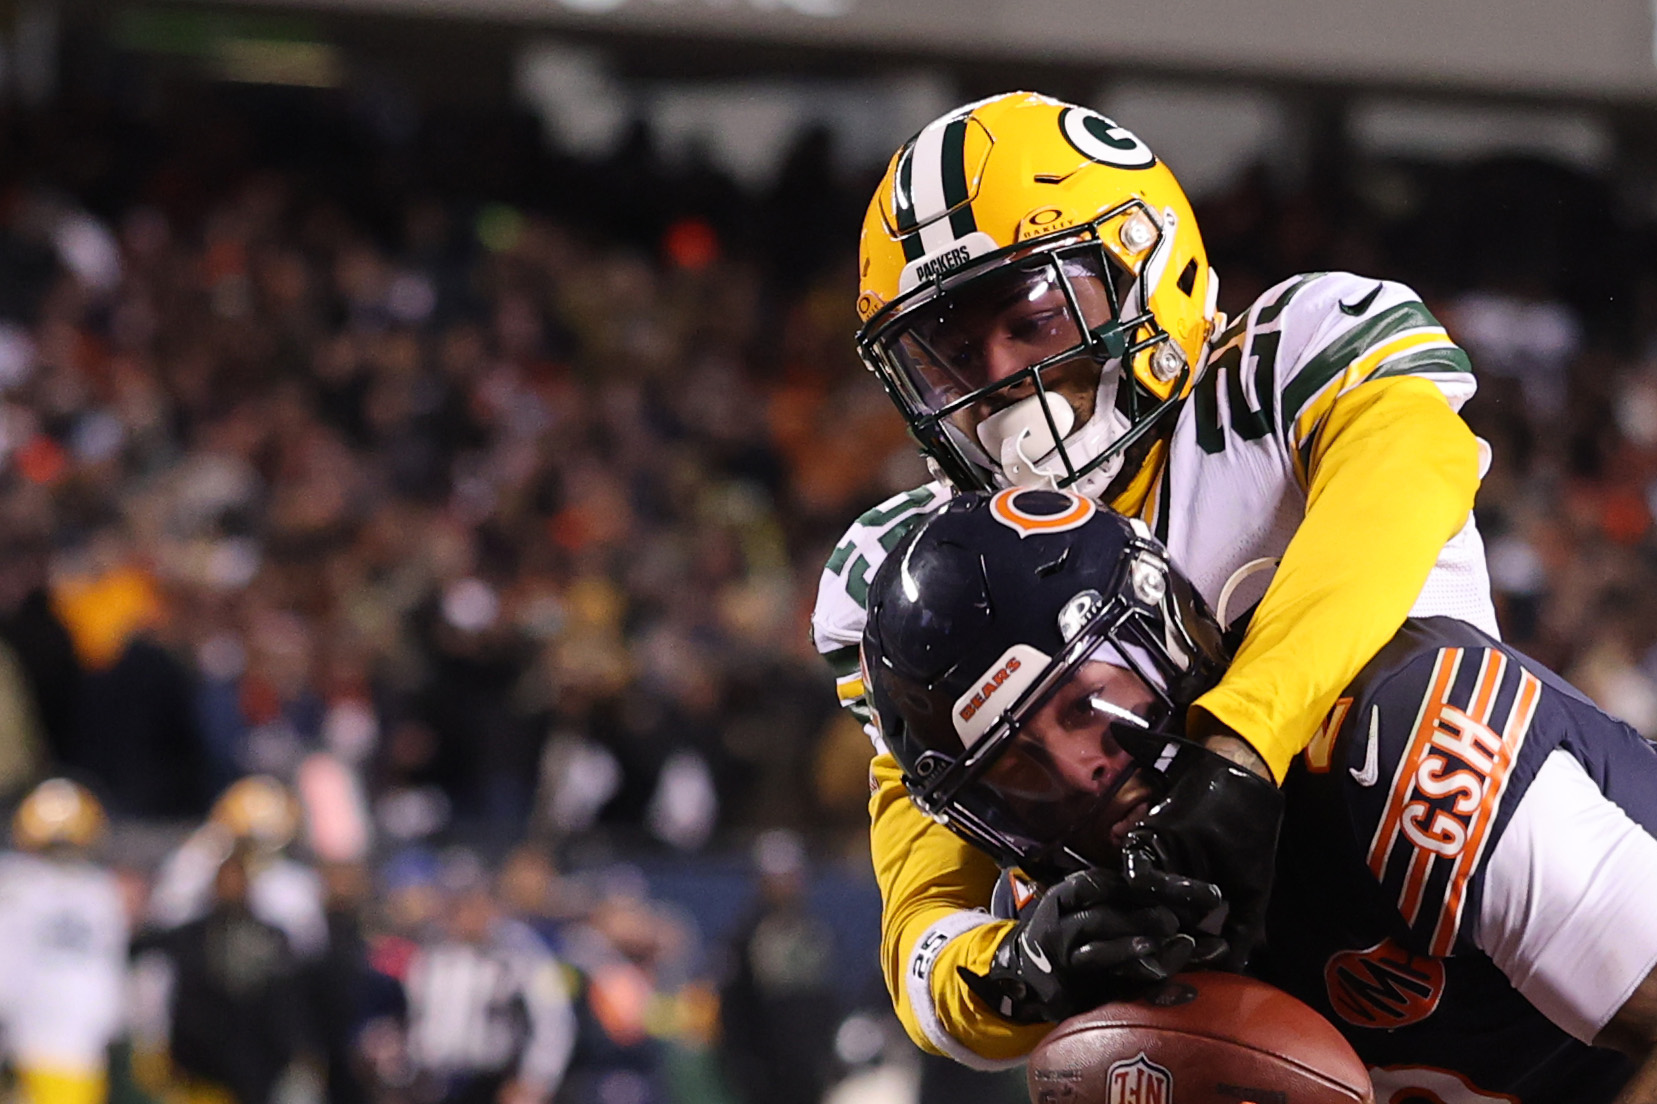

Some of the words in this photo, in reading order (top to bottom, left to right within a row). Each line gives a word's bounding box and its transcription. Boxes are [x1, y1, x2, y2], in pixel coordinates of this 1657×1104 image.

[915, 244, 971, 282] PACKERS
[959, 656, 1023, 723] BEARS
[1401, 702, 1504, 860] GSH
[912, 929, 949, 981] 25
